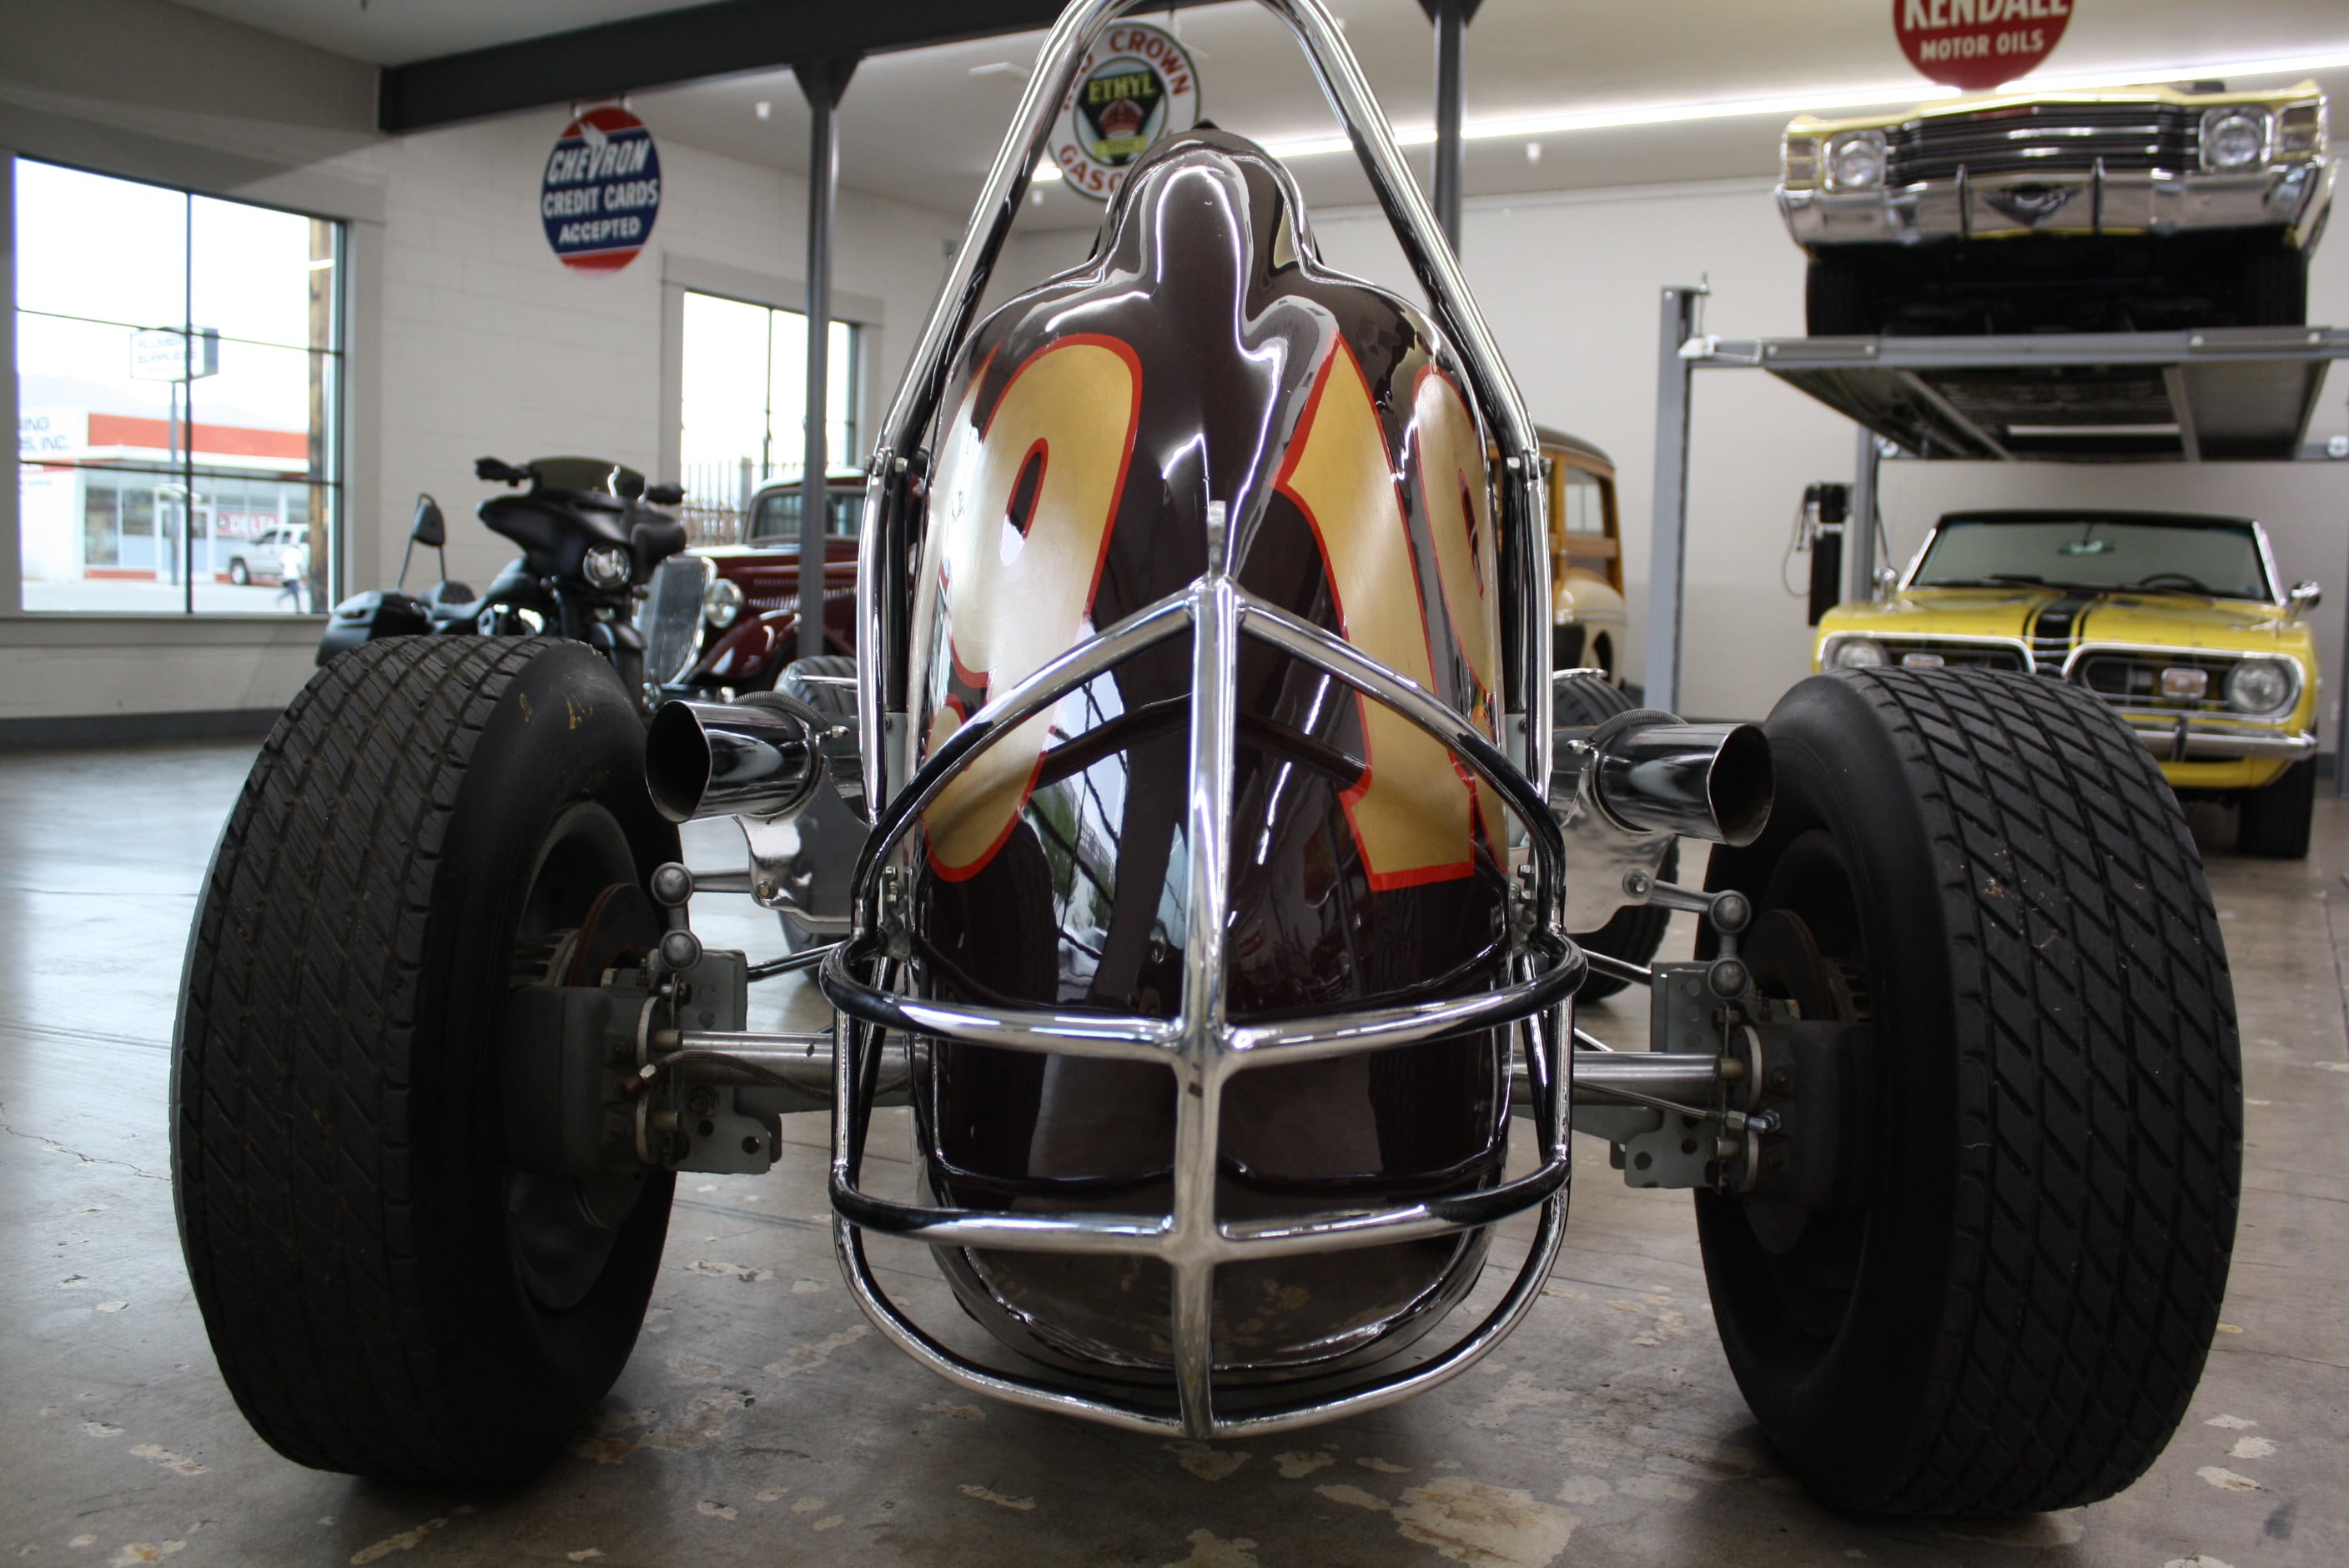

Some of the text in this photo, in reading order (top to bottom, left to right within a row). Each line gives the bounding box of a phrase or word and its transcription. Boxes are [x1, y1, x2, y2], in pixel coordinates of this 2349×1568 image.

[1110, 30, 1190, 96] CROWN
[1921, 30, 2044, 61] MOTOR OILS
[1088, 73, 1155, 102] ETHYL
[547, 138, 651, 183] CHEVRON
[544, 179, 659, 218] CREDIT CARDS
[559, 217, 641, 244] ACCEPTED
